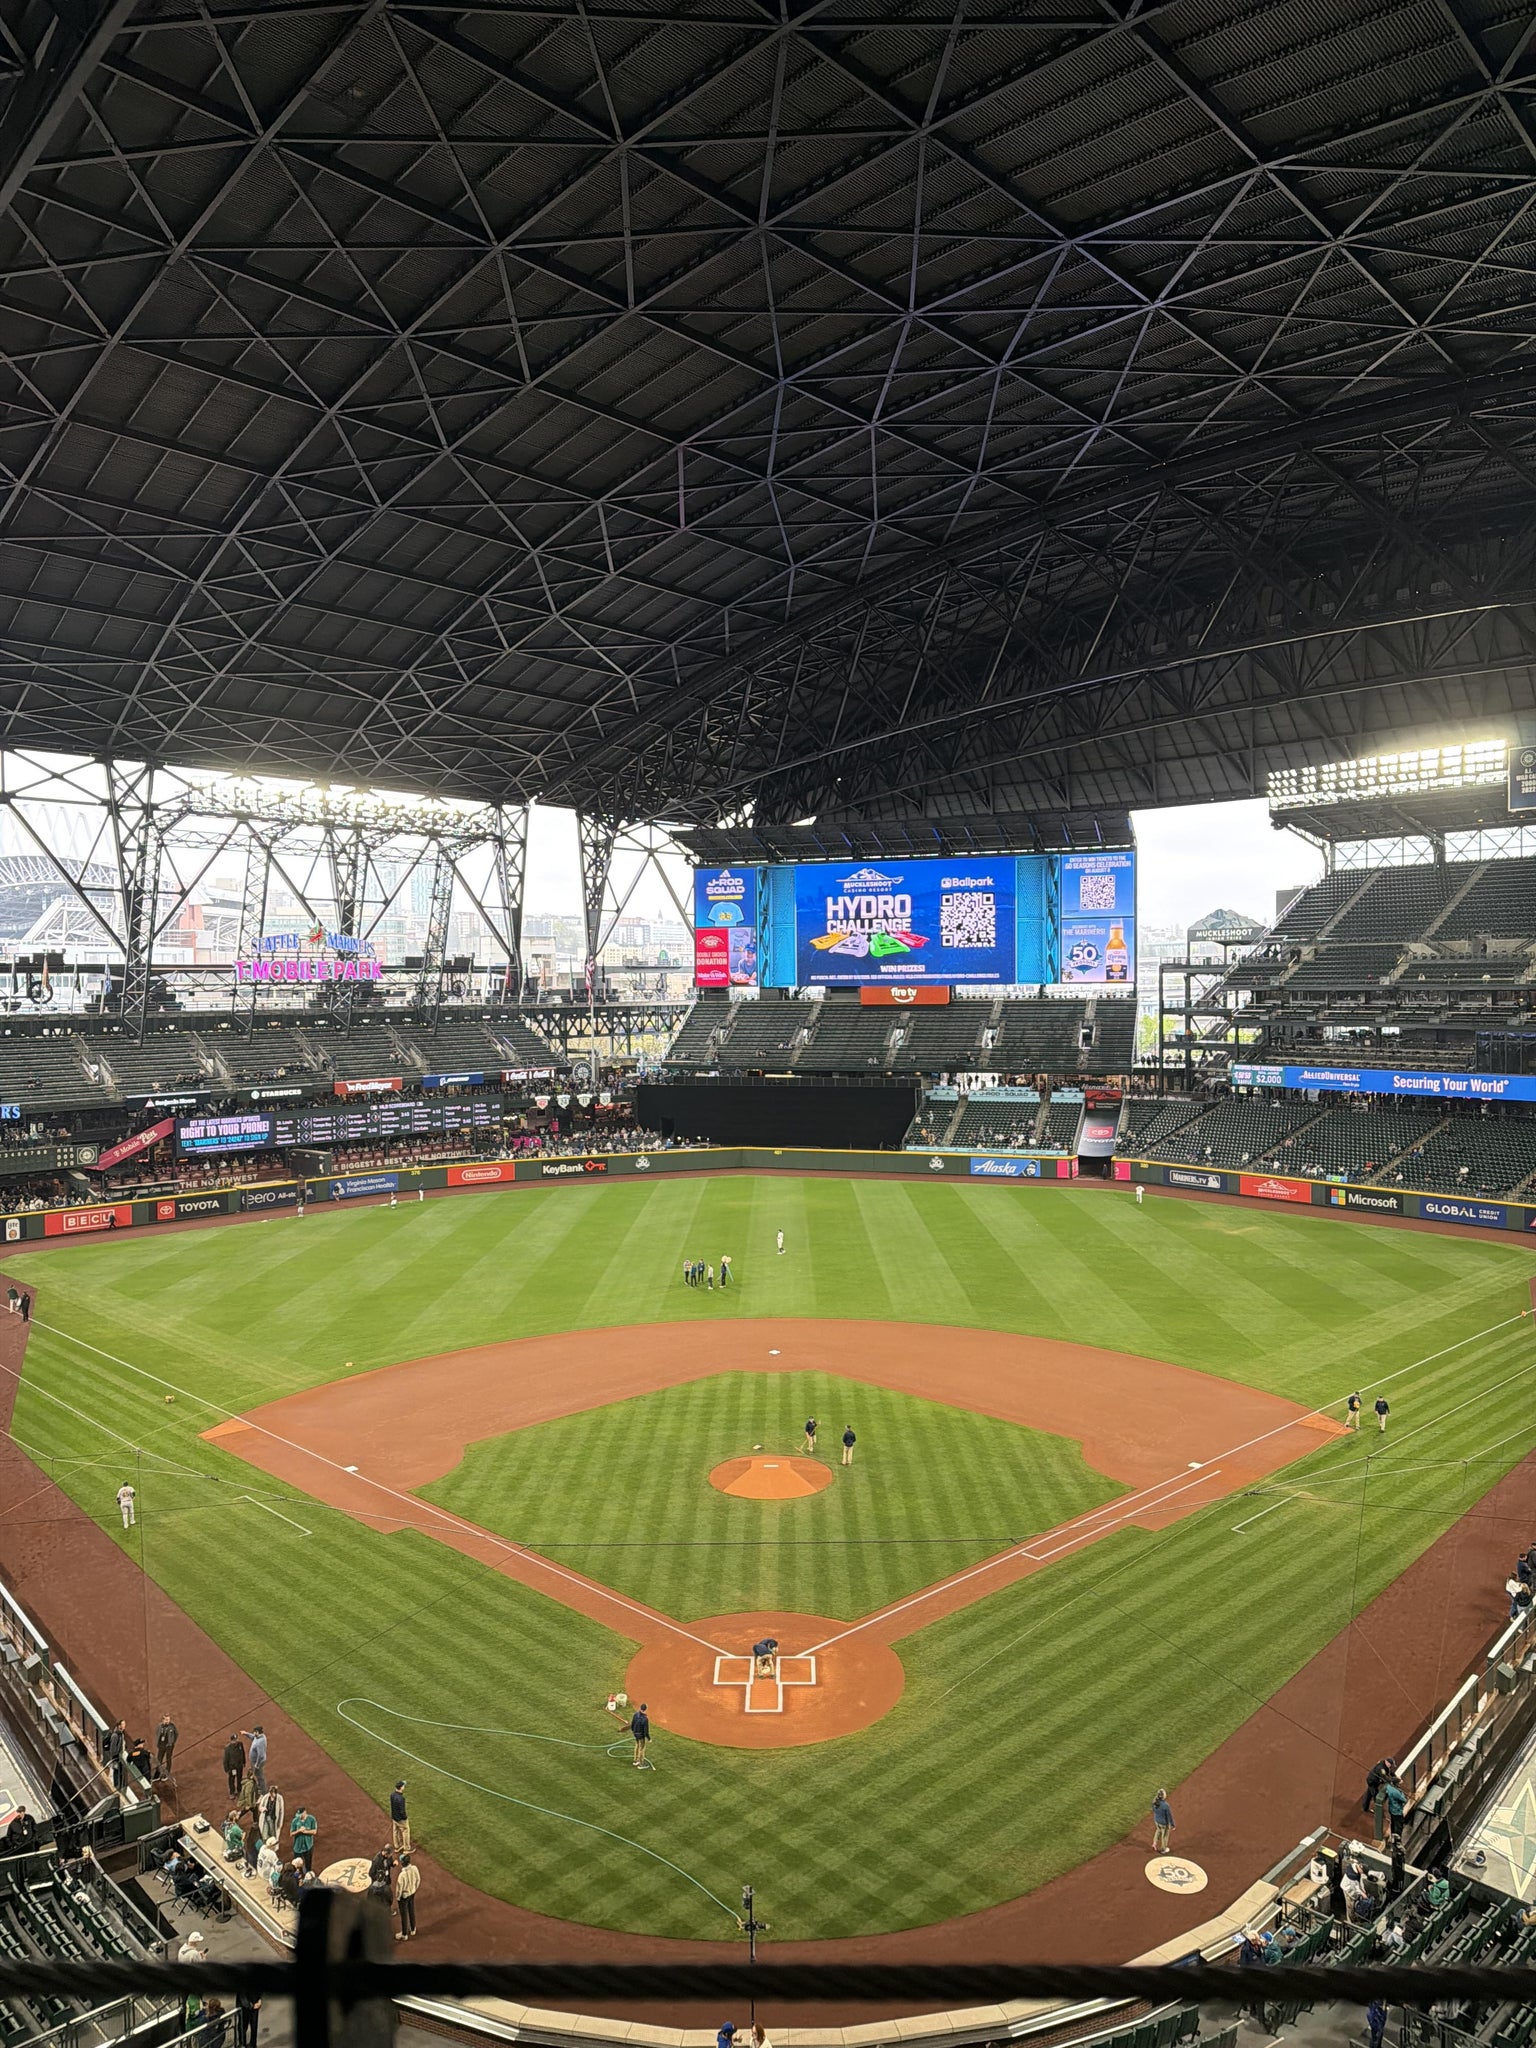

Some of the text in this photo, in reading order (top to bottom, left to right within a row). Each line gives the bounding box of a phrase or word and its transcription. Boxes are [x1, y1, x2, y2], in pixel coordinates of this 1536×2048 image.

[708, 878, 743, 886] J-ROD
[952, 876, 994, 888] Ballpark
[706, 886, 745, 894] SQUAD
[826, 894, 912, 920] HYDRO
[827, 918, 912, 934] CHALLENGE
[1196, 928, 1253, 937] MUCKLESHOOT
[250, 932, 376, 956] SEATTLE MARINERS
[1072, 946, 1097, 961] 50
[233, 960, 384, 981] T-MOBILE PARK
[880, 965, 897, 973] WIN
[890, 987, 917, 996] fire tv
[1256, 1075, 1282, 1084] $2,000
[1394, 1076, 1440, 1092] Securing
[1442, 1078, 1468, 1092] Your
[262, 1090, 302, 1098] STARBUCKS
[180, 1121, 269, 1139] RIGHT TO YOUR PHONE!
[120, 1140, 140, 1155] Mobile
[341, 1160, 374, 1171] BIGGEST
[384, 1157, 402, 1165] BEST
[542, 1162, 584, 1174] KeyBank
[974, 1160, 1017, 1174] Alaska
[180, 1174, 258, 1189] THE NORTHWEST
[347, 1185, 375, 1193] Franciscan
[178, 1200, 220, 1212] TOYOTA
[1348, 1194, 1398, 1208] Microsoft
[1426, 1203, 1476, 1218] GLOBAL
[336, 1864, 368, 1886] A's
[1163, 1868, 1188, 1878] 50
